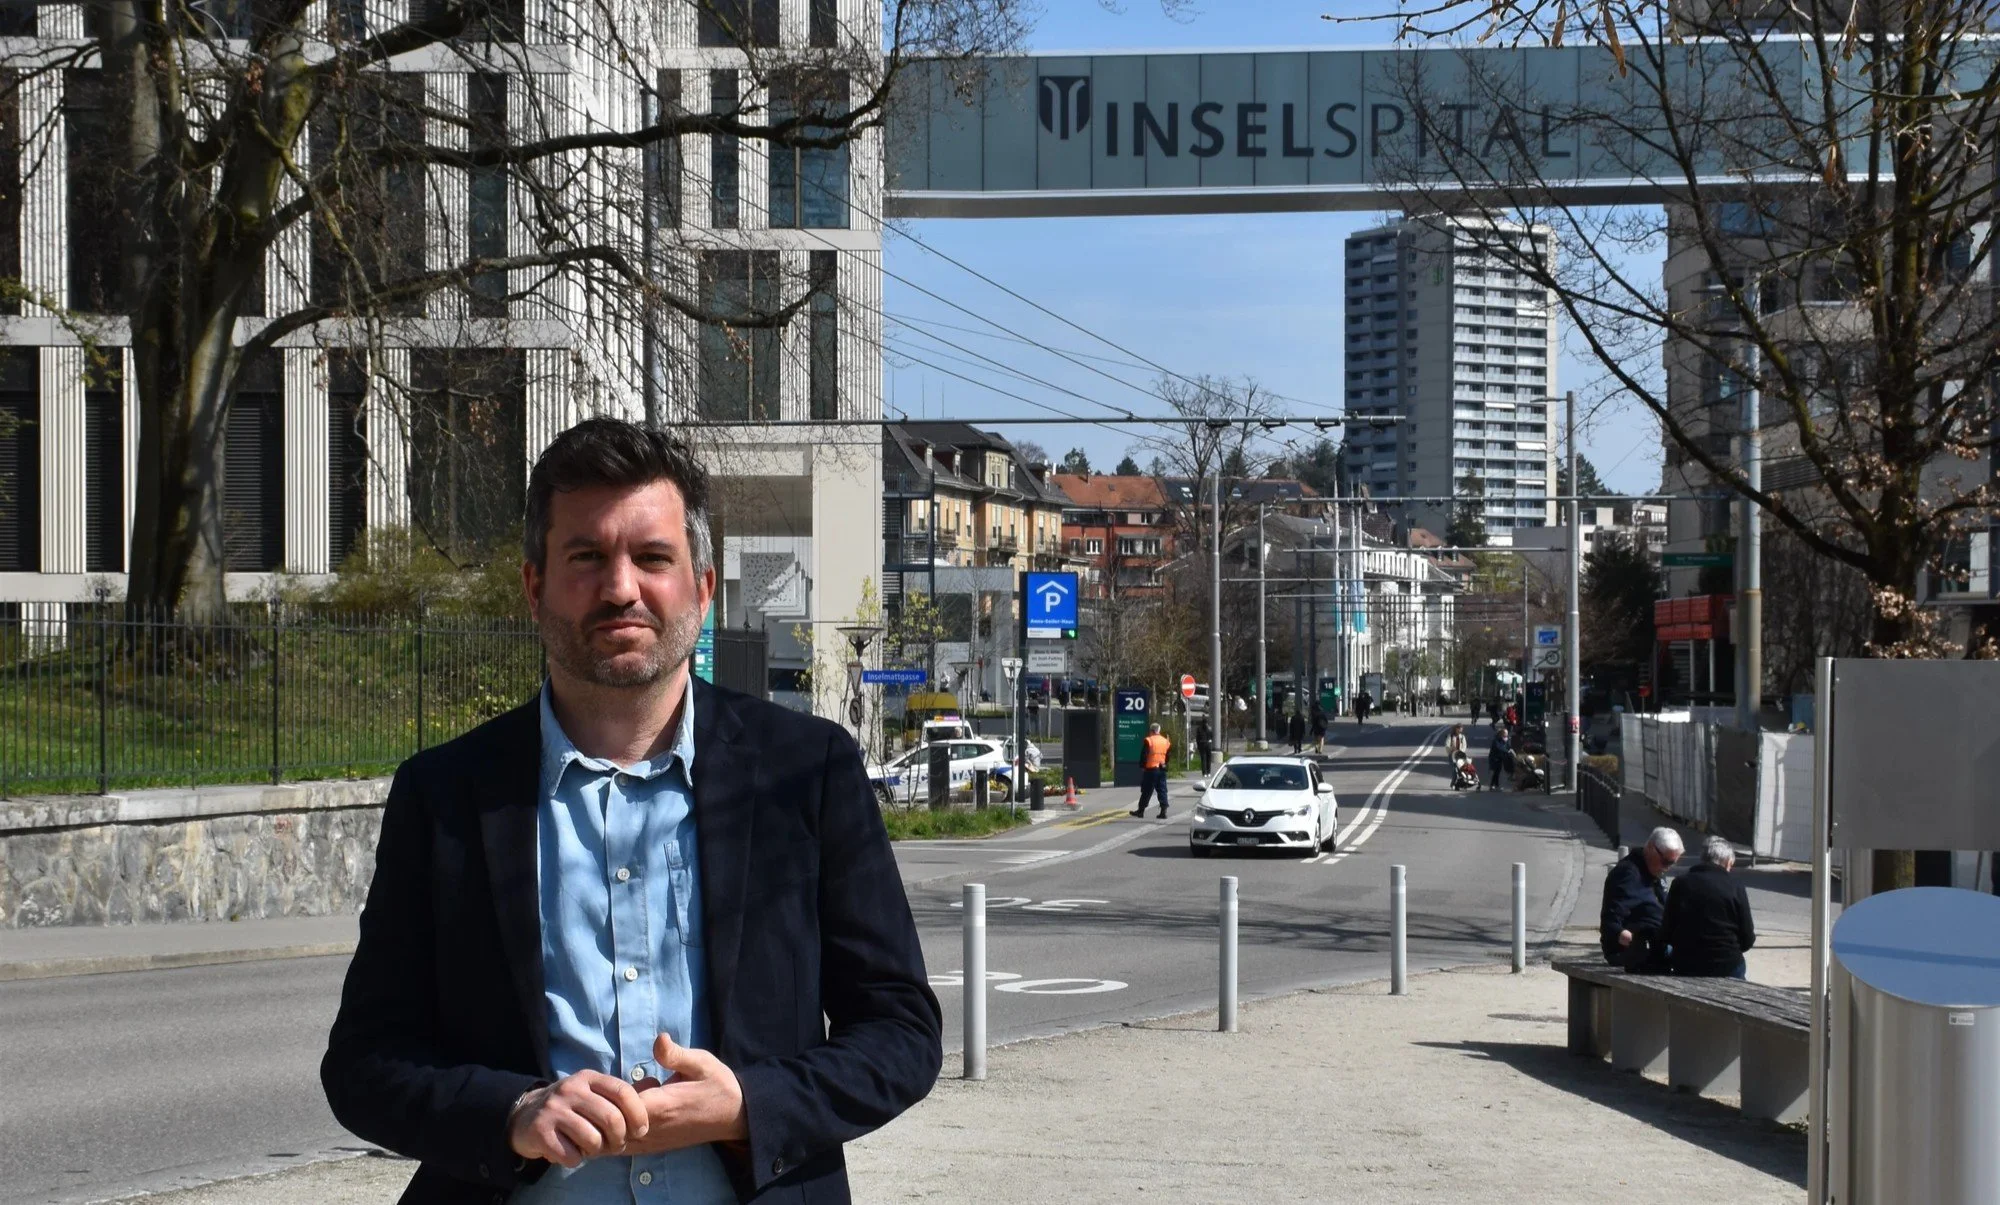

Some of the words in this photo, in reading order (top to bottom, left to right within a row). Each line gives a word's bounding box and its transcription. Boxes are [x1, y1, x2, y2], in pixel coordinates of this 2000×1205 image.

[1107, 102, 1571, 158] INSELSPITAL
[1045, 592, 1061, 613] P
[867, 672, 920, 682] Inselmattgasse
[1125, 697, 1145, 711] 20
